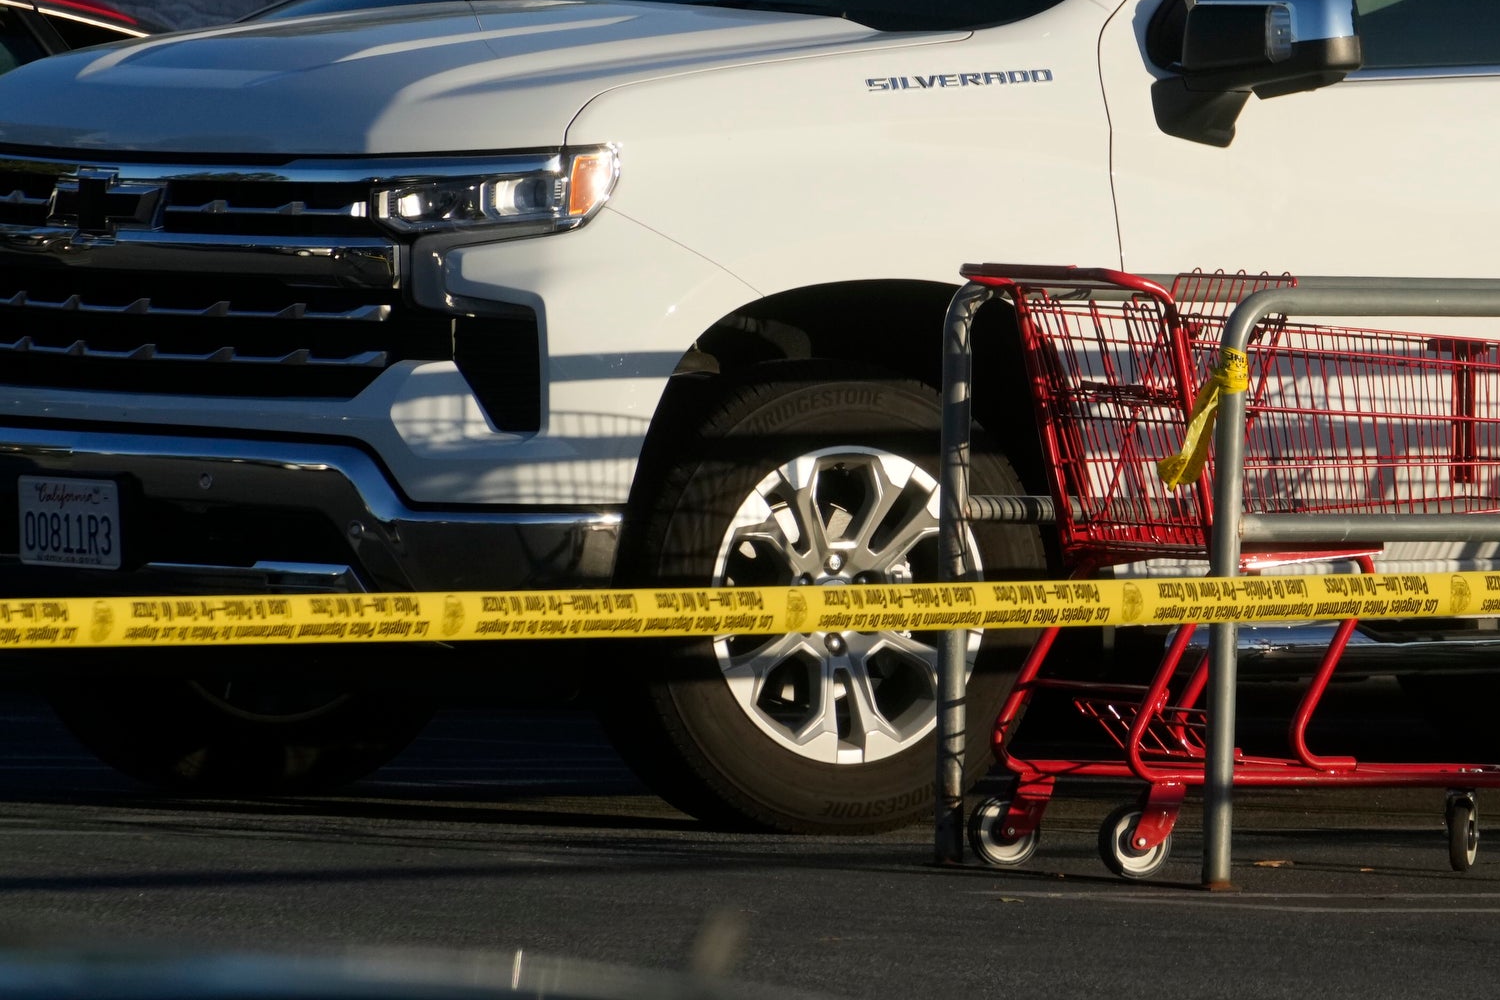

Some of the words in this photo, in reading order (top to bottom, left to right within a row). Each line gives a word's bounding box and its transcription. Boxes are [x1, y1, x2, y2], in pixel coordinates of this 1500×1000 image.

[864, 69, 1054, 92] SILVERADO
[25, 511, 112, 555] 00811R3
[1073, 584, 1100, 603] Police
[1158, 583, 1185, 602] Cruzar
[1185, 583, 1198, 602] No
[1199, 582, 1220, 601] Favor
[1272, 581, 1285, 599] De
[1324, 578, 1347, 597] Cross
[1347, 578, 1363, 596] Not
[1402, 576, 1428, 594] Police
[823, 590, 851, 610] Cruzar
[851, 590, 864, 609] No
[865, 590, 887, 609] Favor
[940, 588, 953, 607] De
[993, 586, 1017, 605] Cross
[1017, 585, 1033, 604] Not
[1060, 606, 1094, 624] Angeles
[1154, 605, 1187, 620] Angeles
[1189, 607, 1202, 619] Los
[1203, 606, 1213, 618] De
[1245, 606, 1255, 618] De
[1255, 603, 1313, 617] Departamento
[1314, 600, 1362, 616] Department
[1363, 601, 1389, 615] Police
[1390, 598, 1422, 615] Angeles
[1424, 600, 1438, 614] Los
[818, 612, 852, 628] Angeles
[854, 615, 868, 627] Los
[869, 614, 879, 627] De
[911, 614, 922, 626] De
[922, 611, 982, 625] Departamento
[983, 608, 1032, 625] Department
[1033, 609, 1059, 624] Police
[1095, 608, 1110, 623] Los
